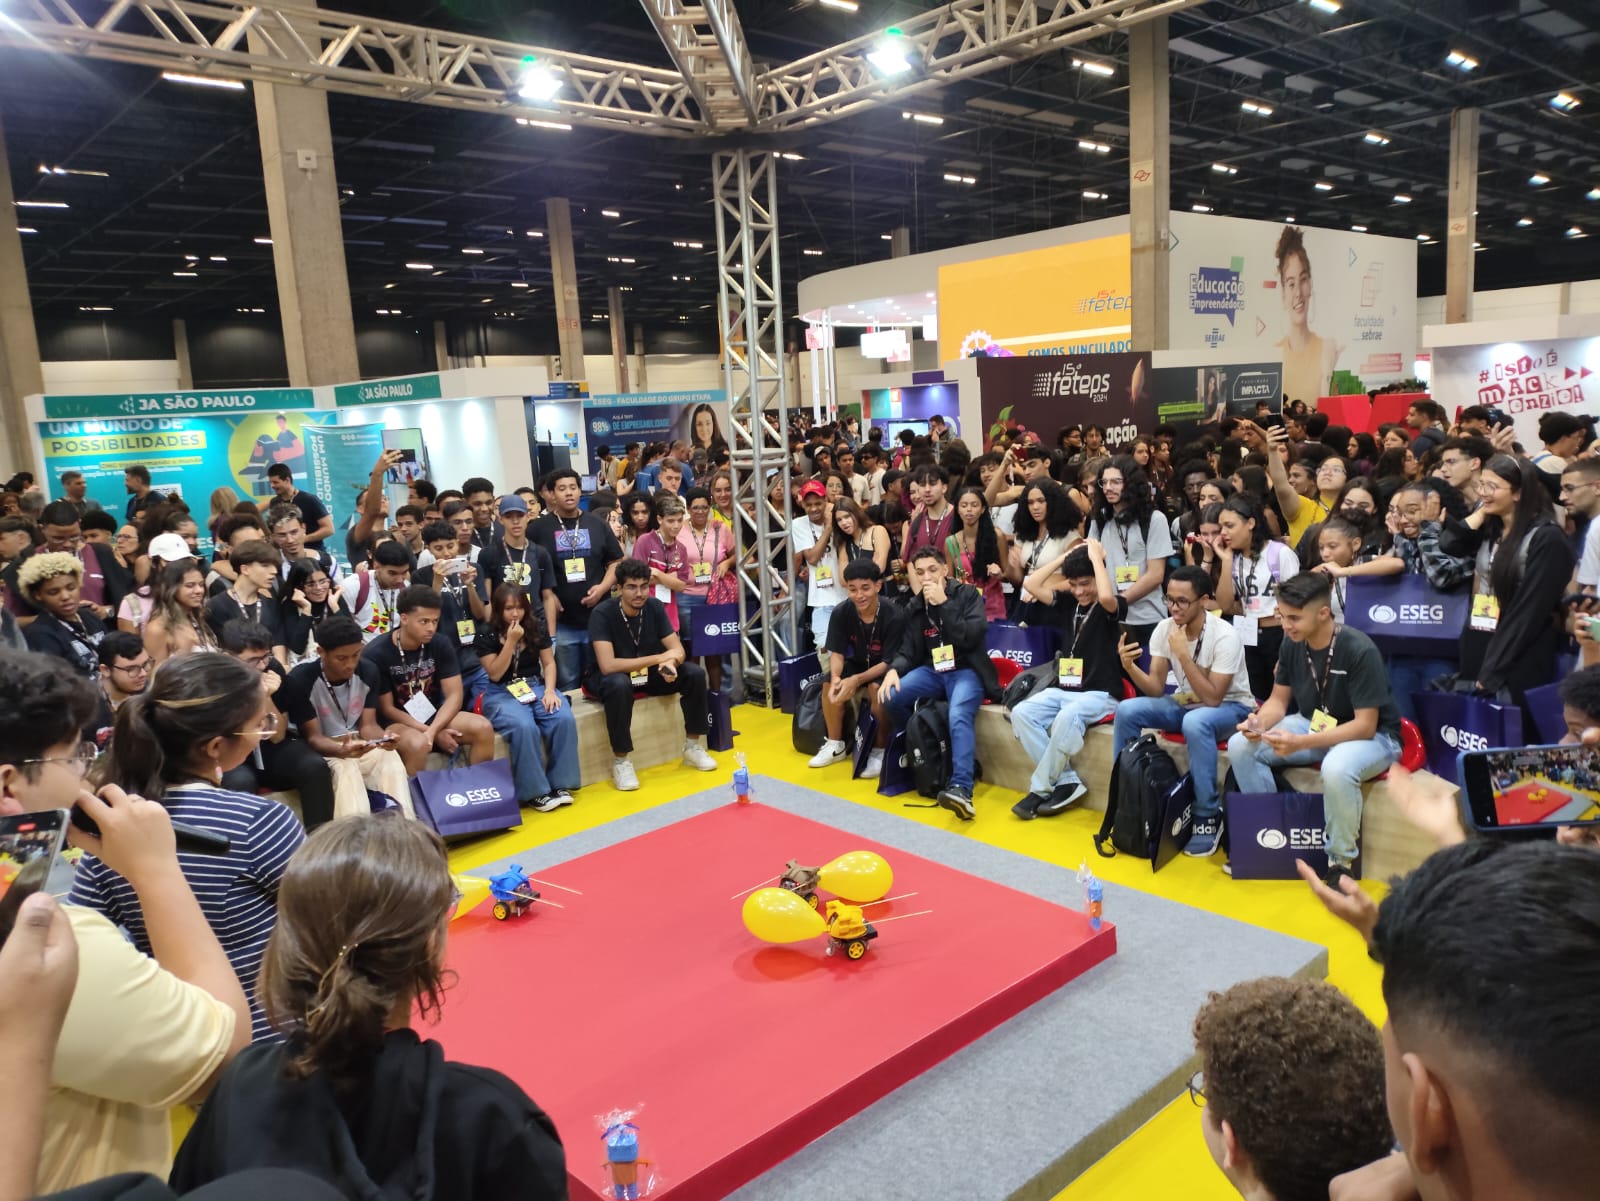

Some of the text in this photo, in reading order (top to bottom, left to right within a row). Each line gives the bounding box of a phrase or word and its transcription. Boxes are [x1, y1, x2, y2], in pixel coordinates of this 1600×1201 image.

[1190, 273, 1245, 299] Educação
[1189, 296, 1245, 311] Empreendedora
[1204, 334, 1225, 342] SEBRAE
[374, 384, 389, 398] SÃO
[389, 383, 413, 396] PAULO
[1052, 371, 1110, 398] feteps
[1241, 384, 1270, 395] IMPACTA
[138, 395, 255, 411] JA SÃO PAULO
[617, 395, 657, 404] FACULDADE
[1093, 394, 1108, 403] 2024
[48, 418, 183, 435] UM MUNDO DE
[592, 421, 609, 433] 98%
[1105, 418, 1137, 448] ação
[52, 434, 200, 453] POSSIBILIDADES
[310, 435, 323, 500] POSSIBILID
[321, 457, 331, 502] MUNDO
[1400, 604, 1444, 620] ESEG
[1458, 729, 1488, 751] ESEG
[466, 787, 500, 802] ESEG
